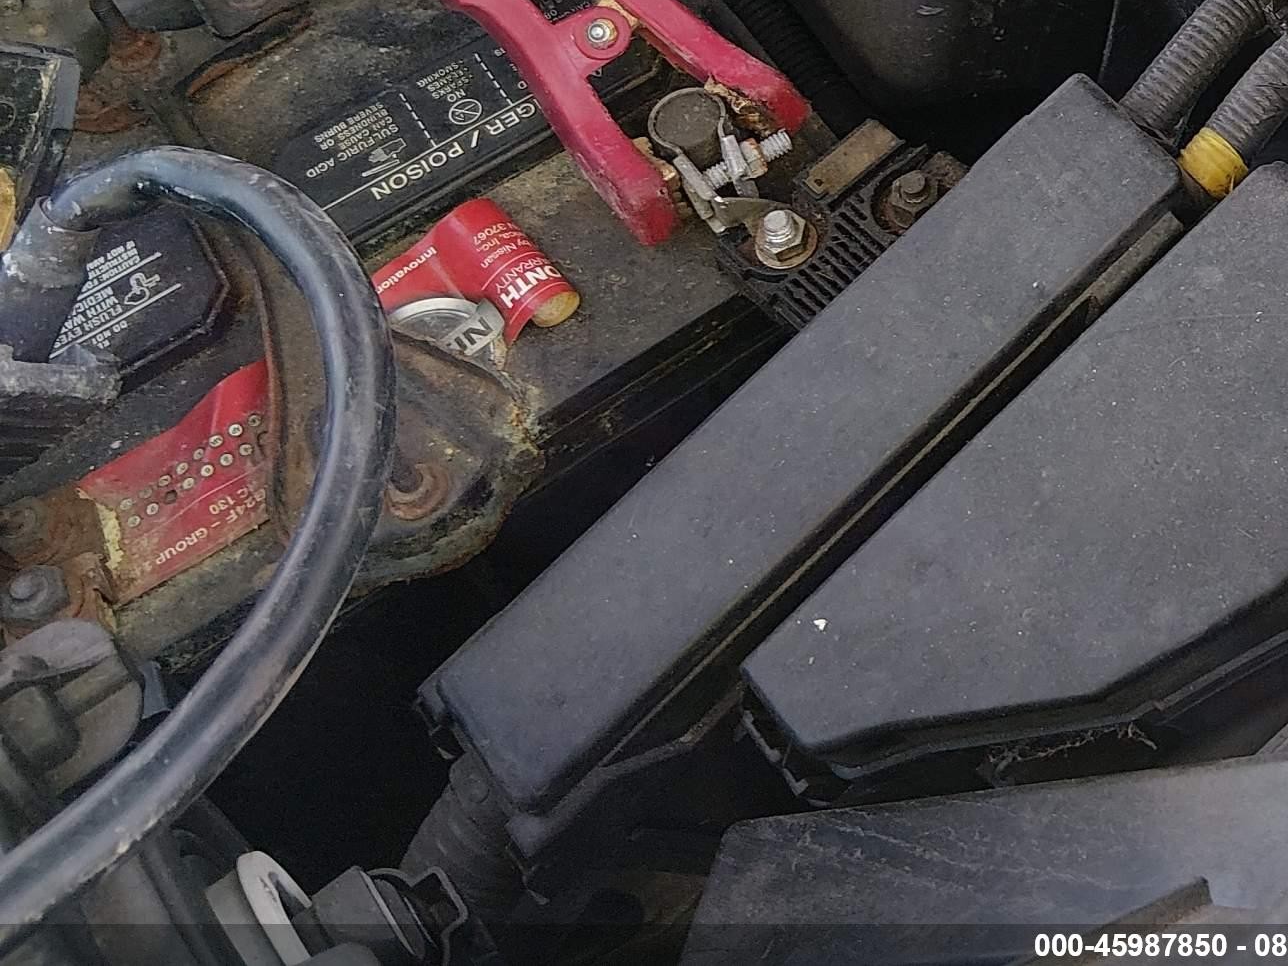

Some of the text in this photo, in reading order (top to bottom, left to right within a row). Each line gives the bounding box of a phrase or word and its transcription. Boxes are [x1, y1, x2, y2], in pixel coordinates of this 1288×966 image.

[416, 61, 457, 88] SMOKING
[431, 75, 468, 100] SPARKS
[444, 87, 466, 104] NO
[313, 101, 382, 143] SEVERE BURNS
[318, 108, 387, 151] BLINDNESS OR
[338, 115, 392, 149] CAN CAUSE
[305, 122, 398, 178] SULFURIC ACID
[371, 142, 463, 200] POISON
[473, 223, 505, 245] 37067
[481, 243, 517, 268] Nissan
[495, 257, 549, 293] RRANTY
[68, 286, 113, 317] MEDIC
[85, 296, 118, 318] WITH
[83, 304, 123, 331] FLUSH
[449, 316, 494, 351] NI
[209, 495, 235, 514] 130
[155, 527, 209, 565] GROUP
